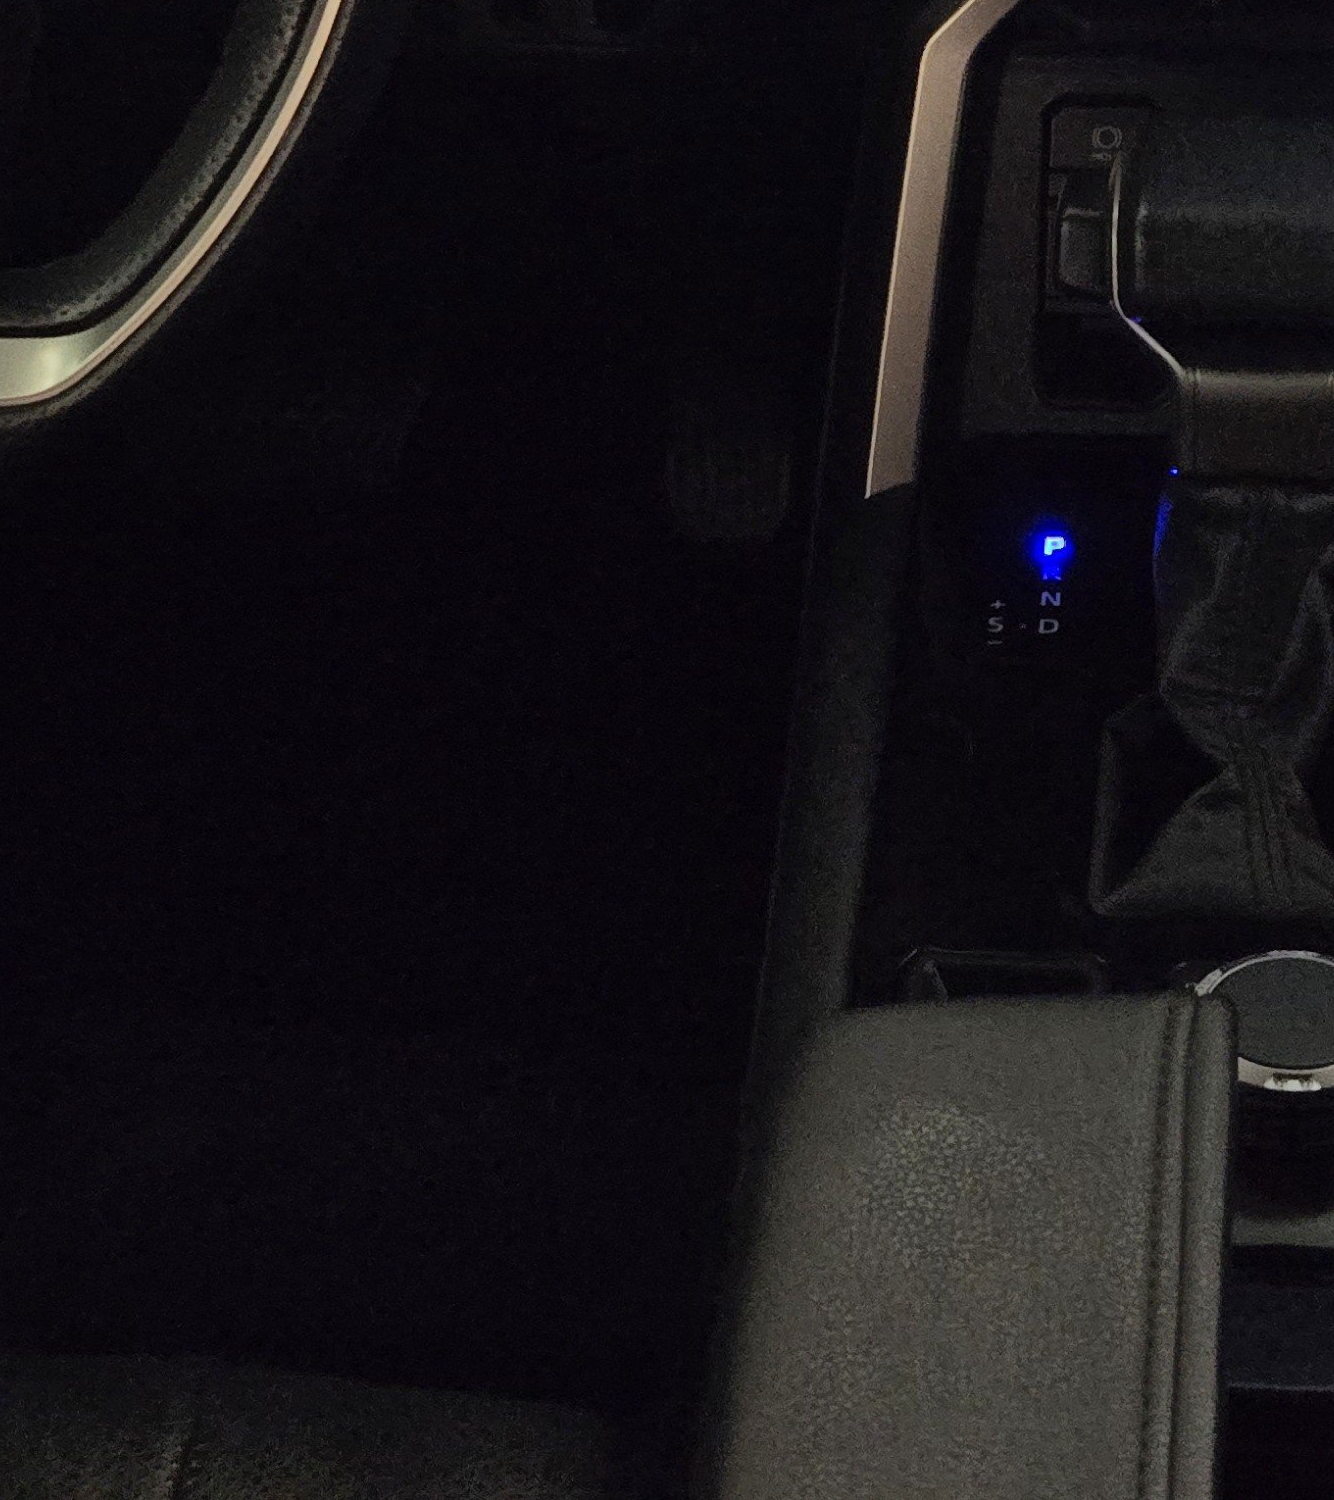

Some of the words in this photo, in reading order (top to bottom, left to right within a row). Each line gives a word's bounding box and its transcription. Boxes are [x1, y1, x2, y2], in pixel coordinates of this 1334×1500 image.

[1043, 535, 1066, 556] P
[1040, 591, 1062, 607] N
[1038, 618, 1060, 634] D
